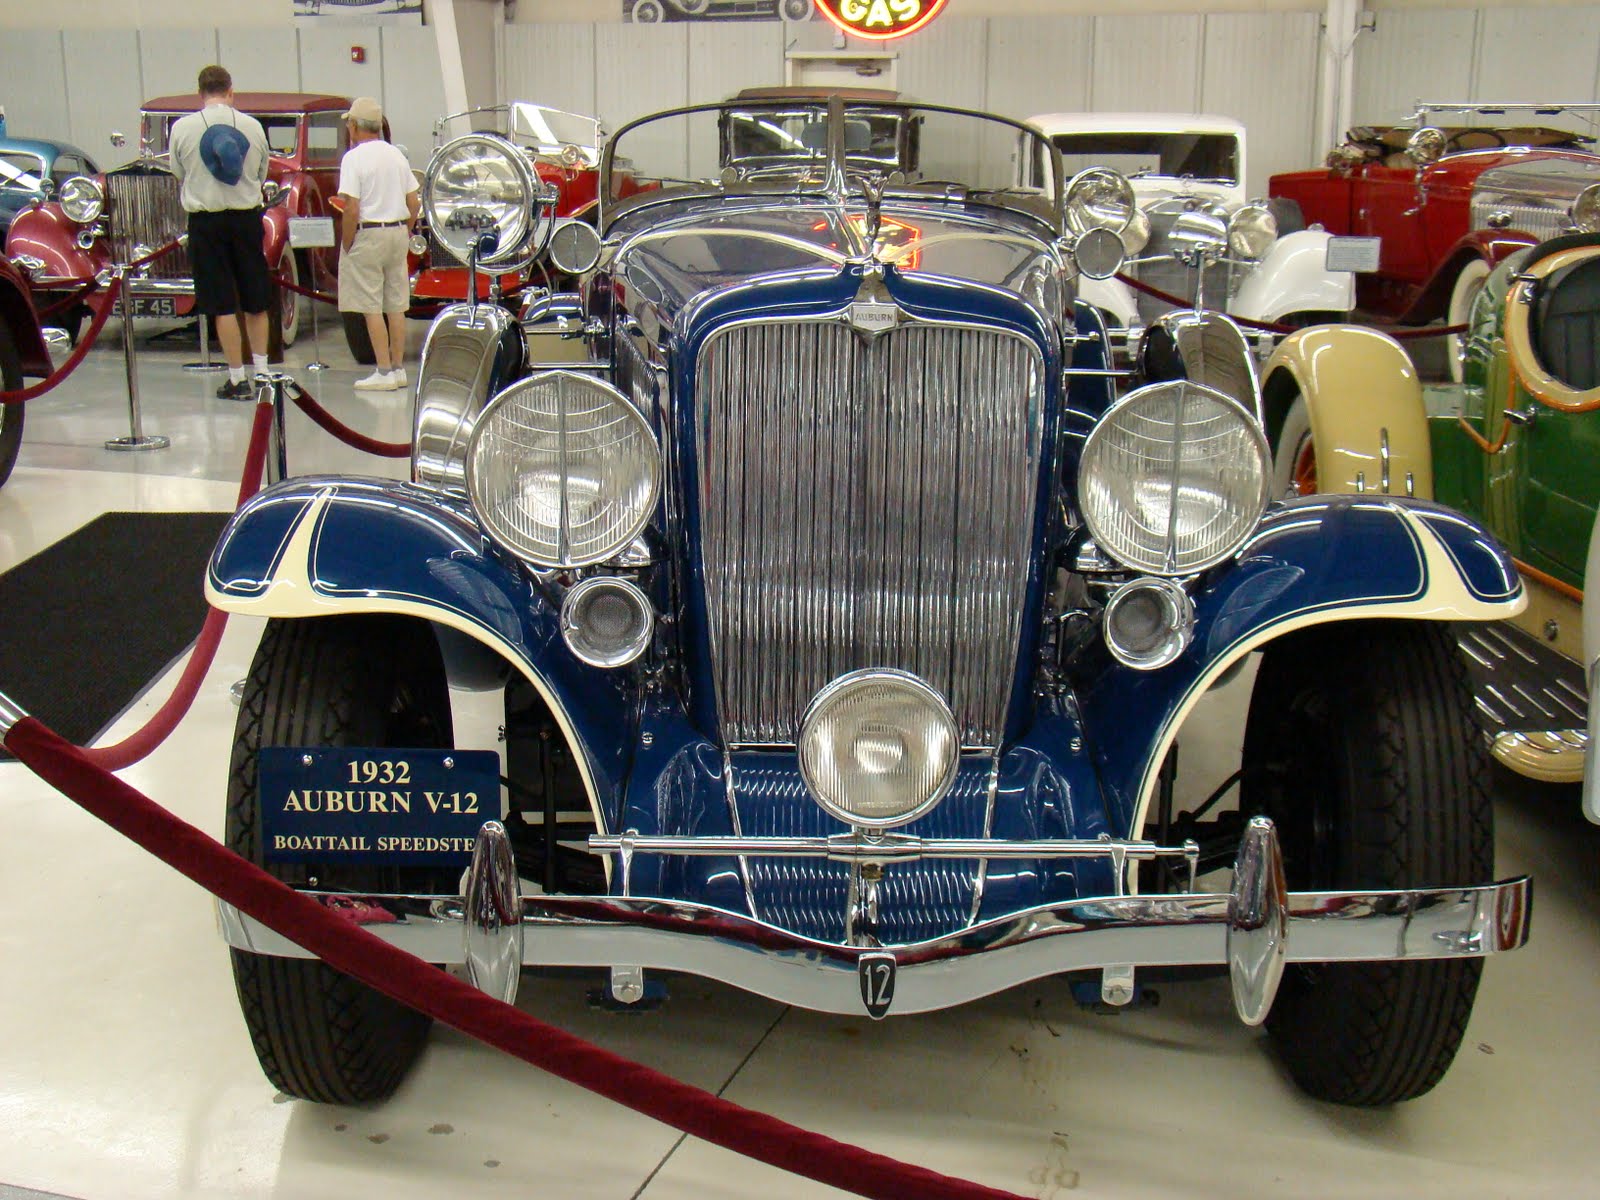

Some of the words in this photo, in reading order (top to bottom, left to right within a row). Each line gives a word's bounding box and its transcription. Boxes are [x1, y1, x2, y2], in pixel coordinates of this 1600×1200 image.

[840, 0, 920, 27] GAS
[112, 299, 145, 315] EF
[150, 299, 172, 315] 45
[855, 312, 893, 322] AUBURN
[348, 760, 411, 785] 1932
[282, 789, 412, 814] AUBURN
[423, 791, 480, 814] V-12
[274, 835, 371, 851] BOATTAIL
[864, 964, 891, 1006] 12
